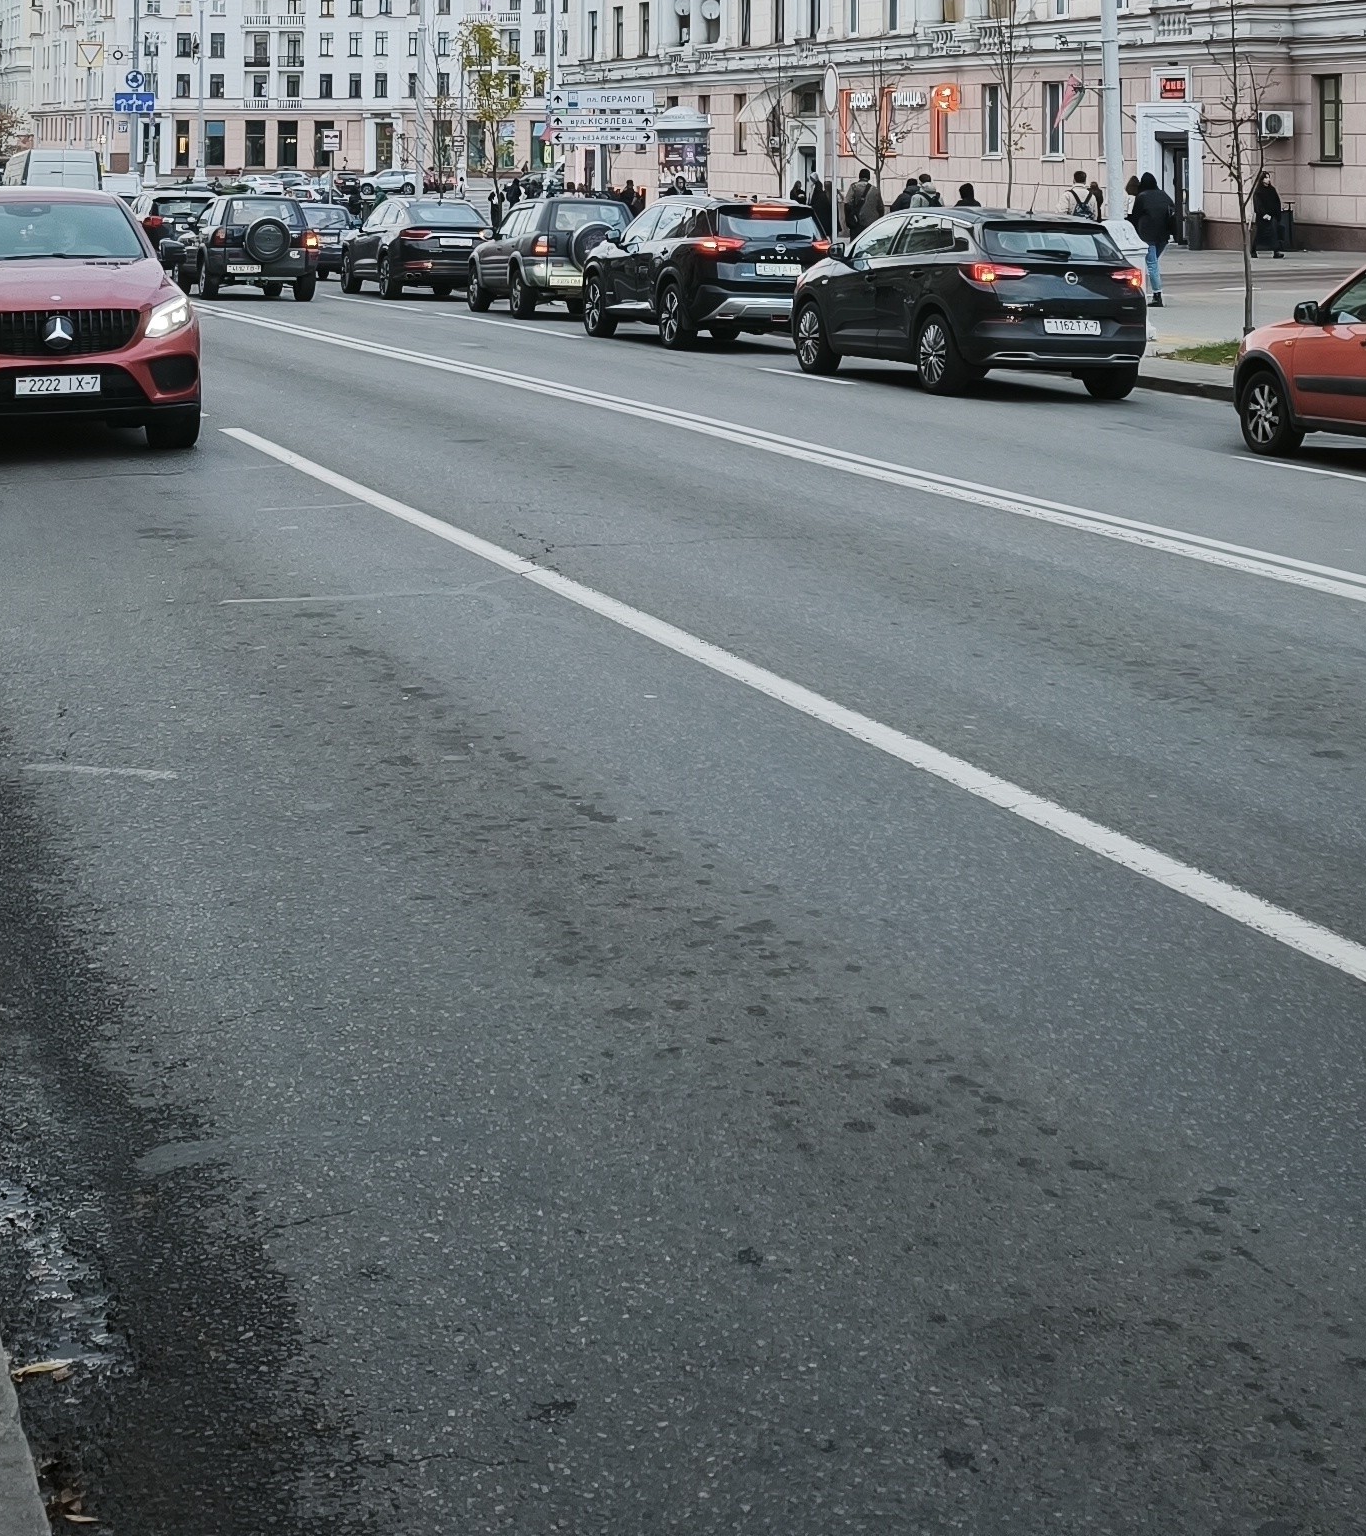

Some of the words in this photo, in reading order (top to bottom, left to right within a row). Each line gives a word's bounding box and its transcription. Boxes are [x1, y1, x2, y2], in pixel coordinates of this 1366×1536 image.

[600, 95, 645, 103] ПЕРАМОГІ
[849, 92, 874, 109] ДОДО
[891, 91, 923, 107] ПИЦЦА
[588, 117, 634, 125] КІСЯЛЕВА
[29, 378, 61, 392] 2222
[69, 376, 99, 391] IX-7
